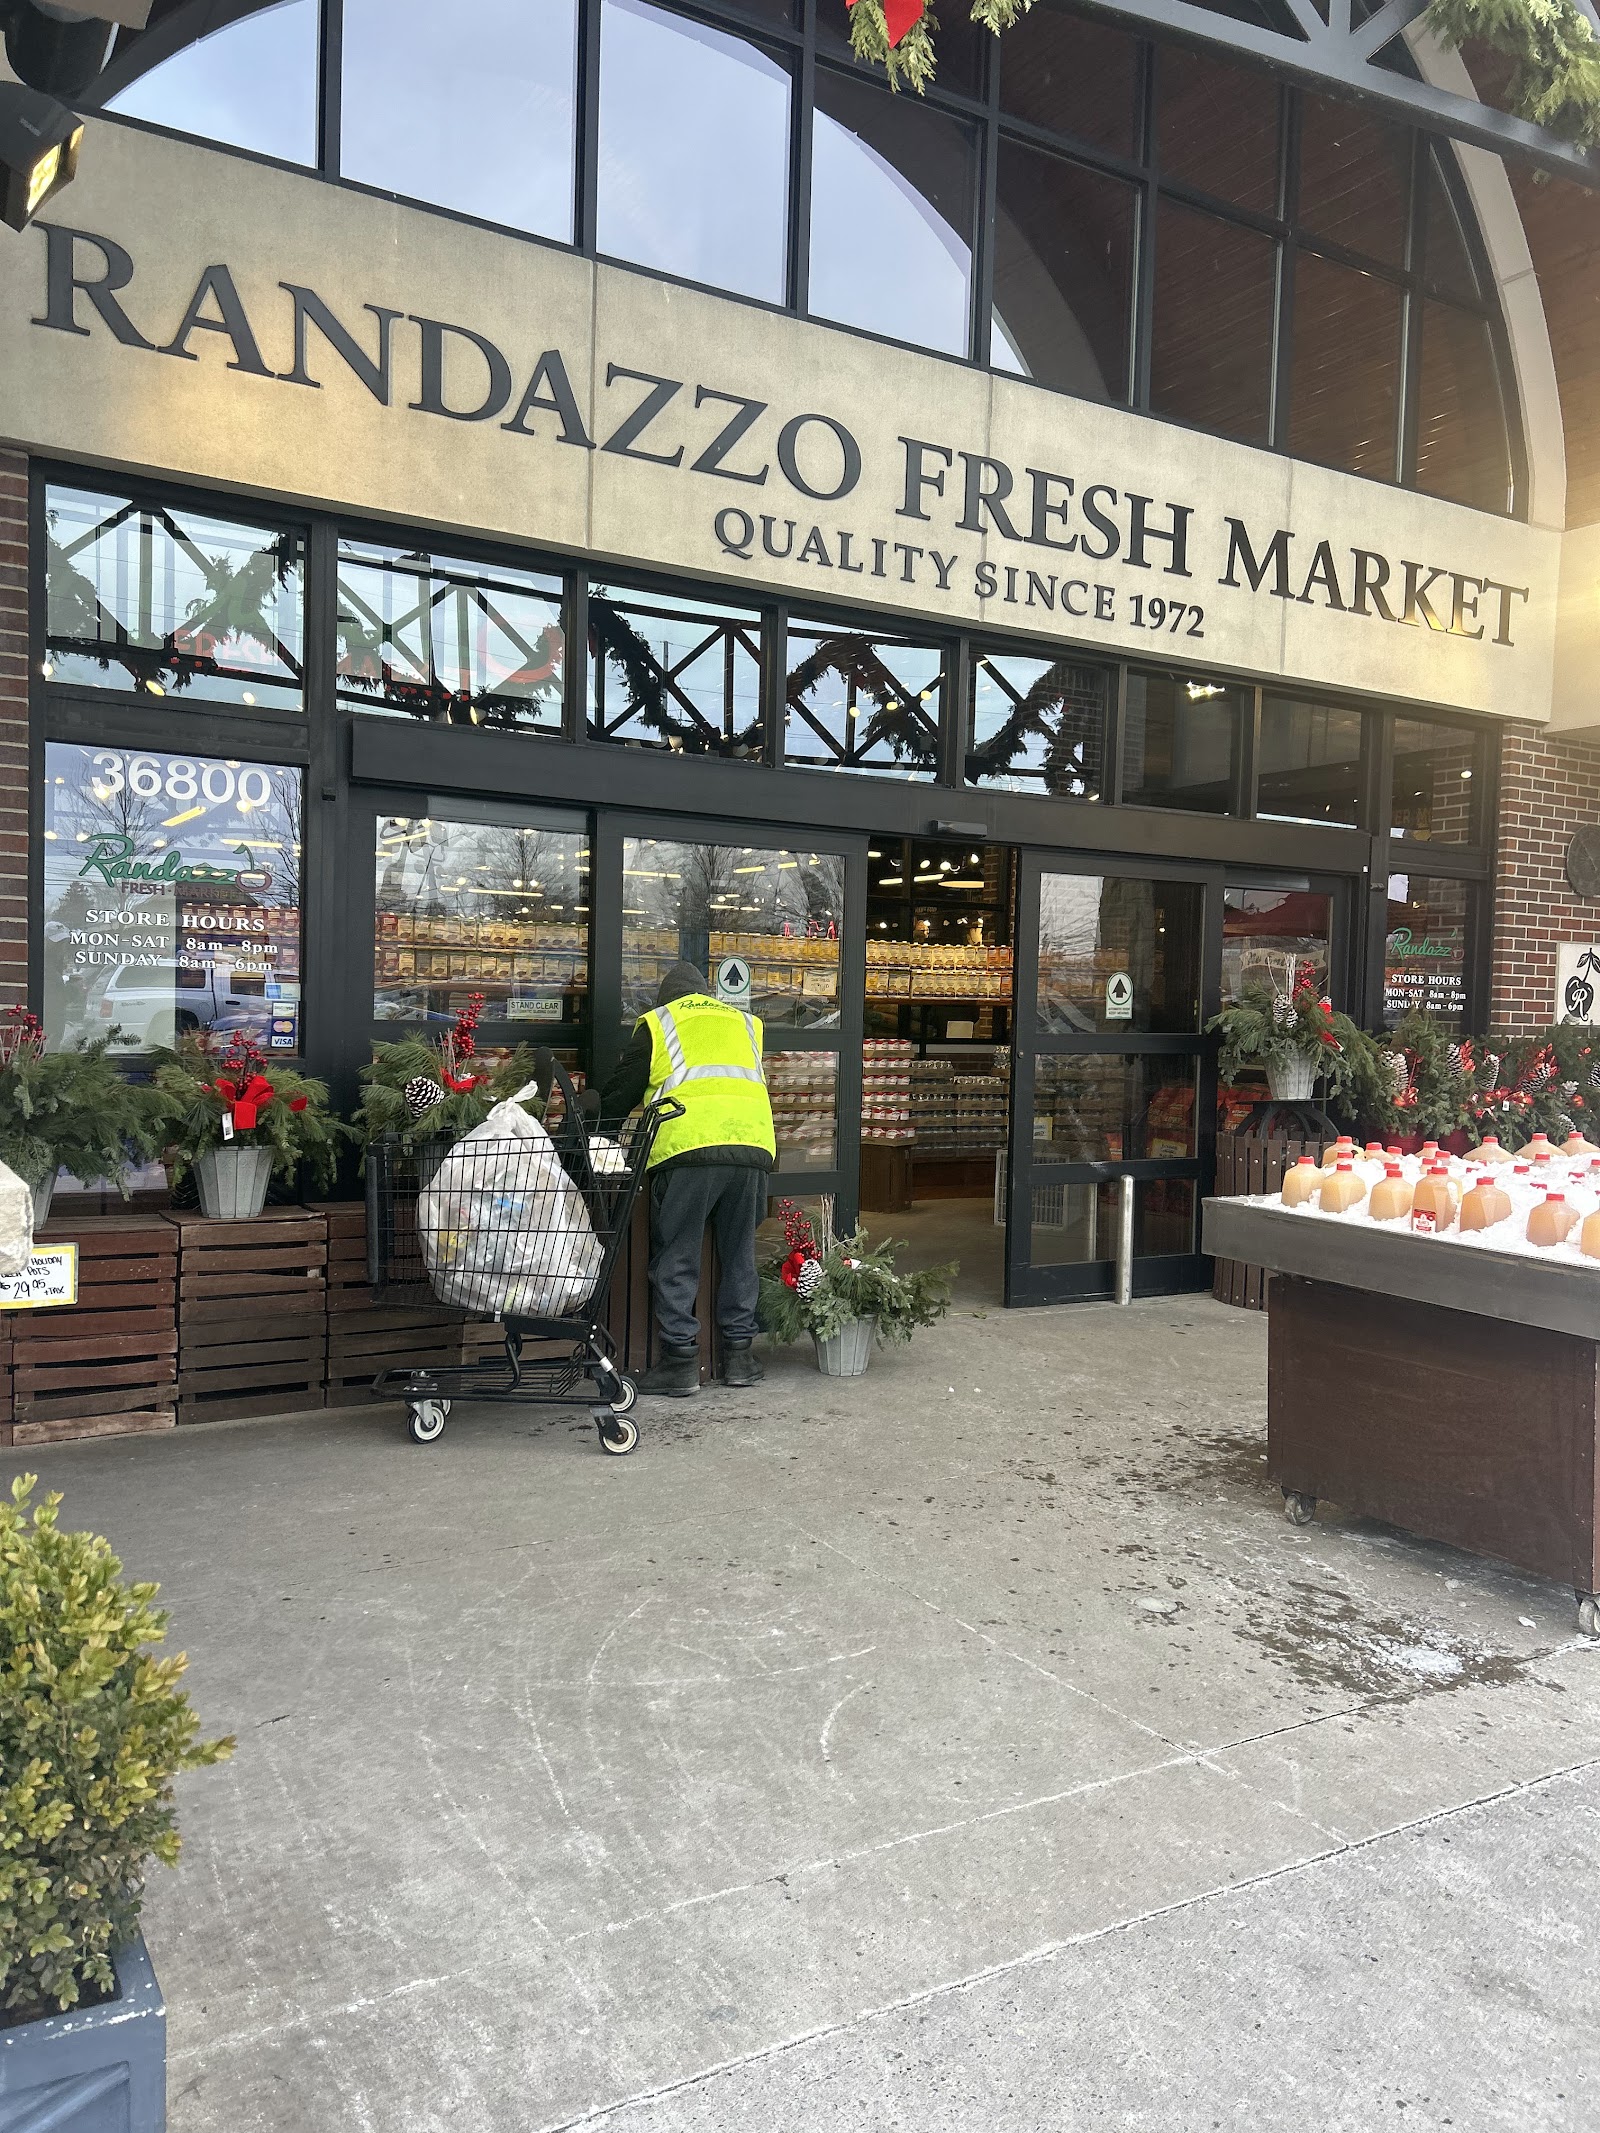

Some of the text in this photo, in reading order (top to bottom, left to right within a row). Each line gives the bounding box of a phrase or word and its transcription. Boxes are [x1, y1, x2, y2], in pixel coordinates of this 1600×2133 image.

[30, 220, 1530, 647] RANDAZZO FRESH MARKET
[714, 507, 1206, 638] QUALITY SINCE 1972
[91, 751, 271, 807] 36800
[79, 833, 272, 893] Randazzo
[121, 881, 165, 895] FRESH
[85, 909, 265, 931] STORE HOURS
[69, 930, 170, 949] MON-SAT
[185, 937, 223, 951] 8am
[241, 940, 279, 954] 8pm
[75, 951, 272, 972] SUNDAY 8am 6pm
[1391, 974, 1462, 986] STORE HOURS
[1385, 988, 1424, 998] MON-SAT
[1429, 990, 1444, 999] 8am
[1450, 991, 1467, 1001] 8pm
[1568, 987, 1589, 1022] R
[511, 1001, 559, 1010] STAND CLEAR
[1426, 1001, 1442, 1010] 8am
[26, 1265, 51, 1276] POTS
